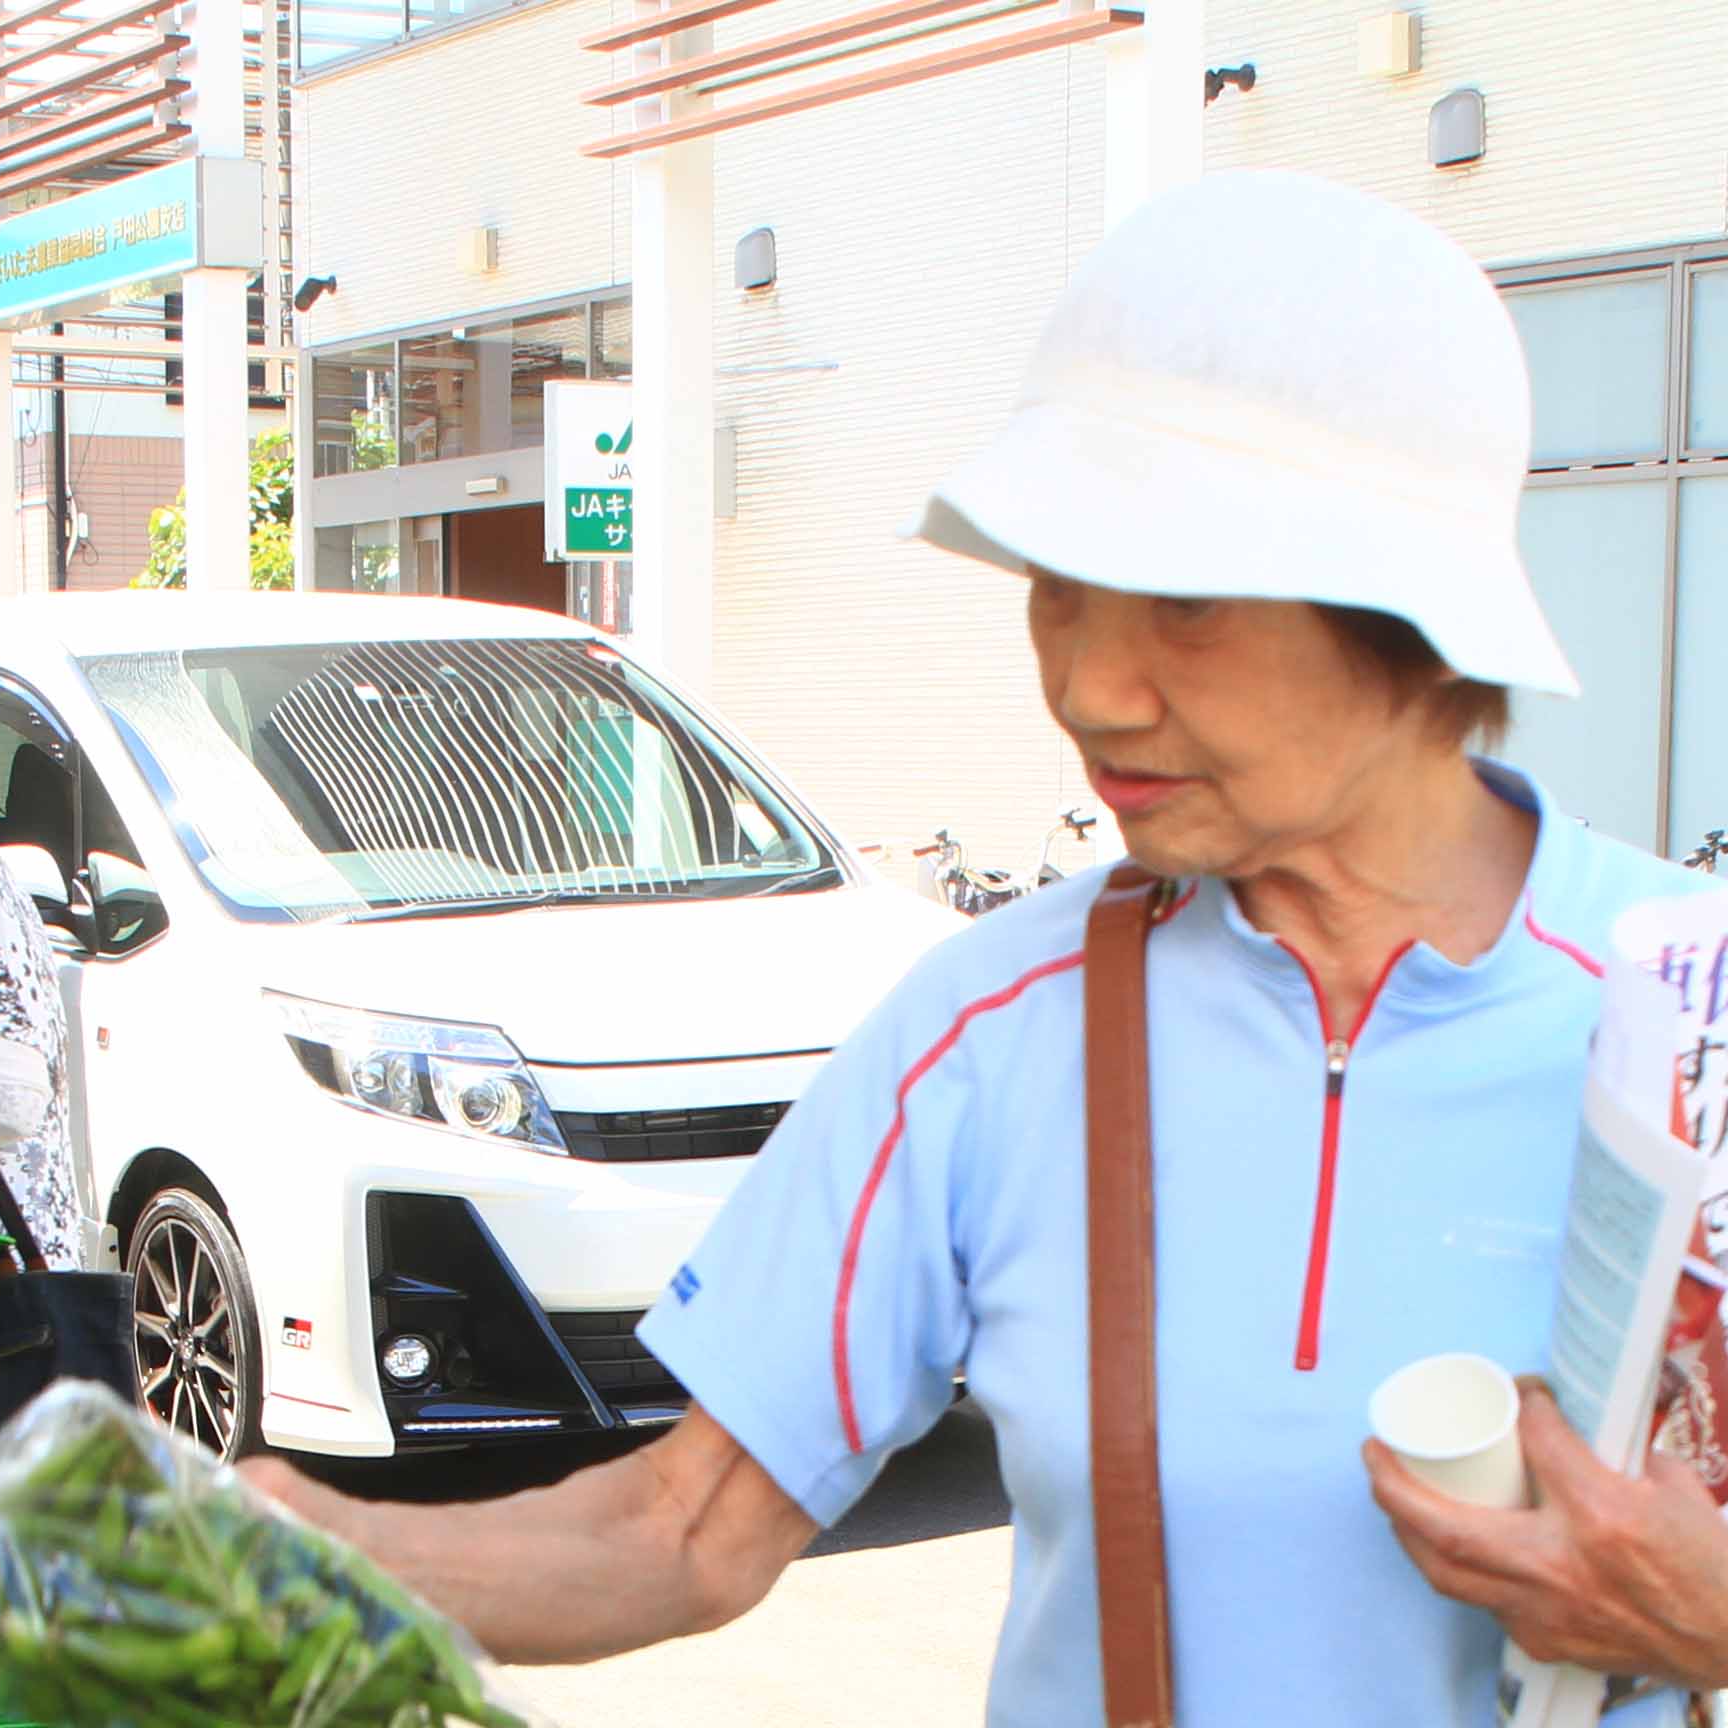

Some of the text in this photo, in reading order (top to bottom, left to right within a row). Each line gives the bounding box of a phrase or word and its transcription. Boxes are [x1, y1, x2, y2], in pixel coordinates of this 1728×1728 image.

[570, 493, 632, 520] JAキ
[604, 523, 632, 546] サ
[282, 1327, 312, 1350] GR
